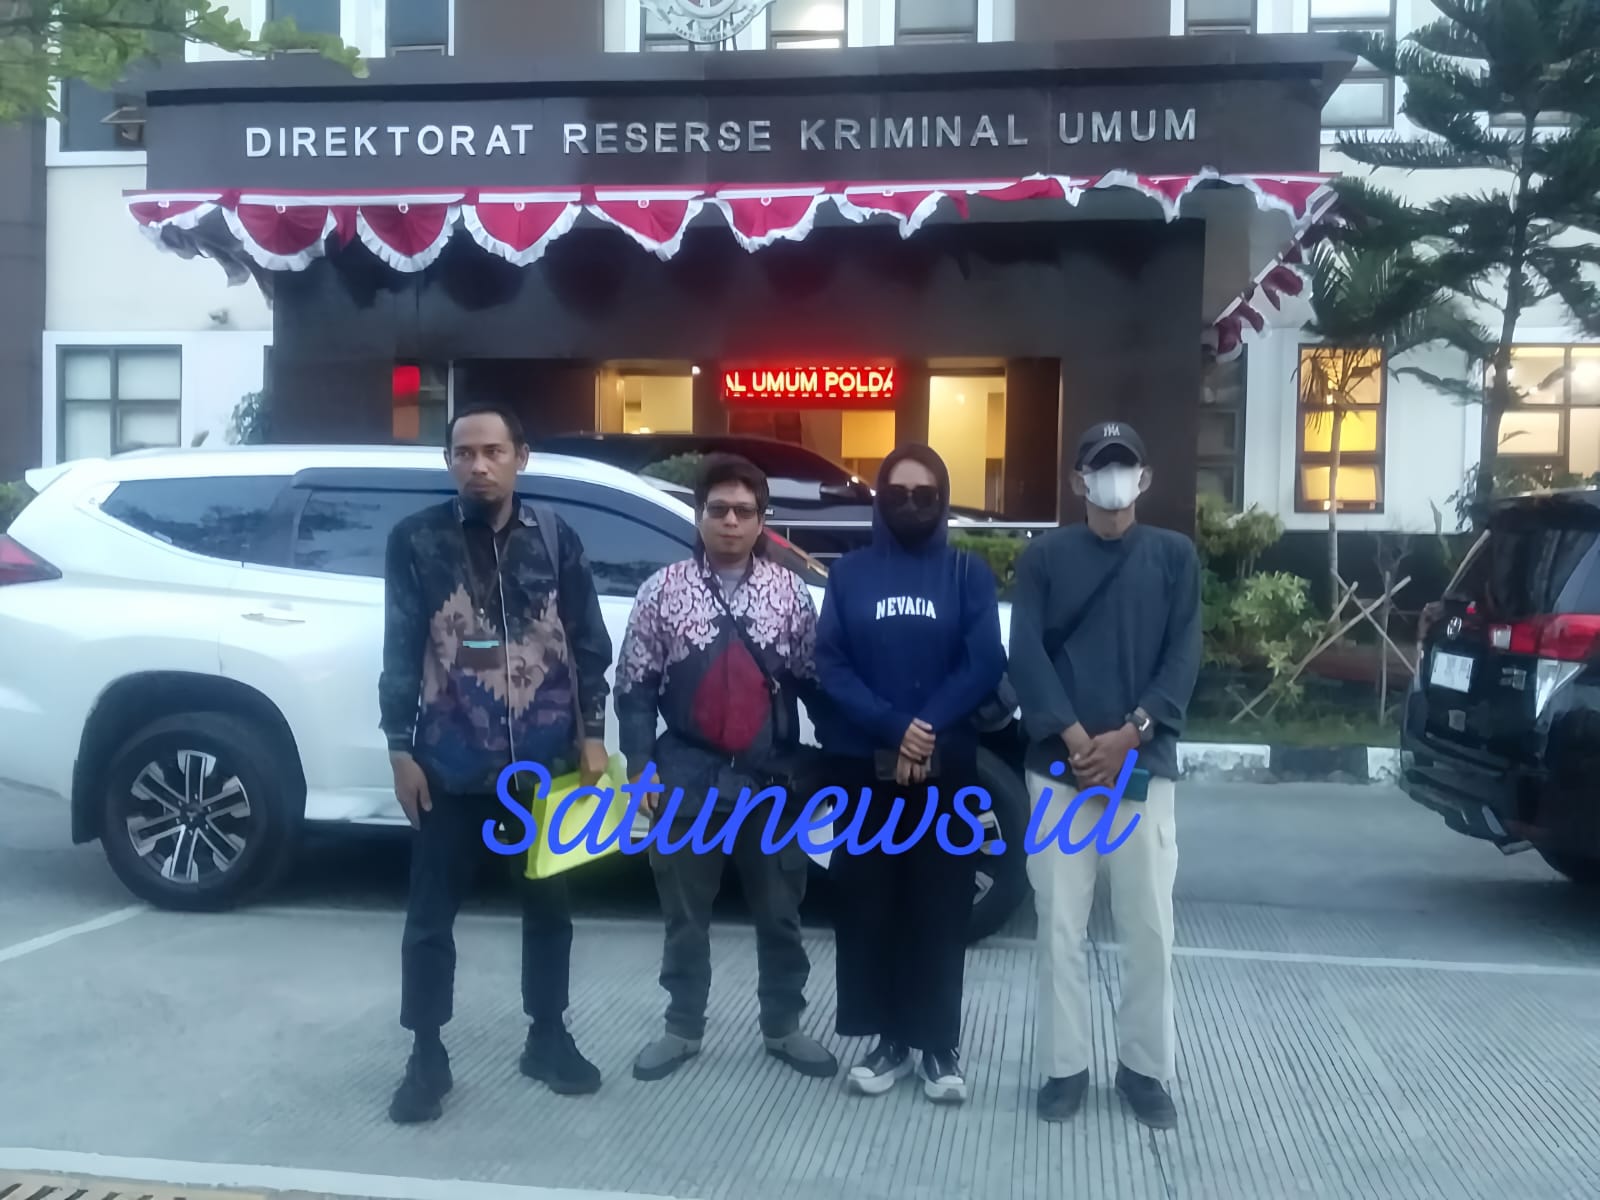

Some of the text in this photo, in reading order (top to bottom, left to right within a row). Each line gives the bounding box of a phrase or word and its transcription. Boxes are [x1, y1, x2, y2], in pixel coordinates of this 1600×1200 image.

[246, 107, 1197, 158] DIREKTORAT RESERSE KRIMINAL UMUM
[752, 371, 818, 392] UMUM
[875, 595, 937, 620] NEVADA
